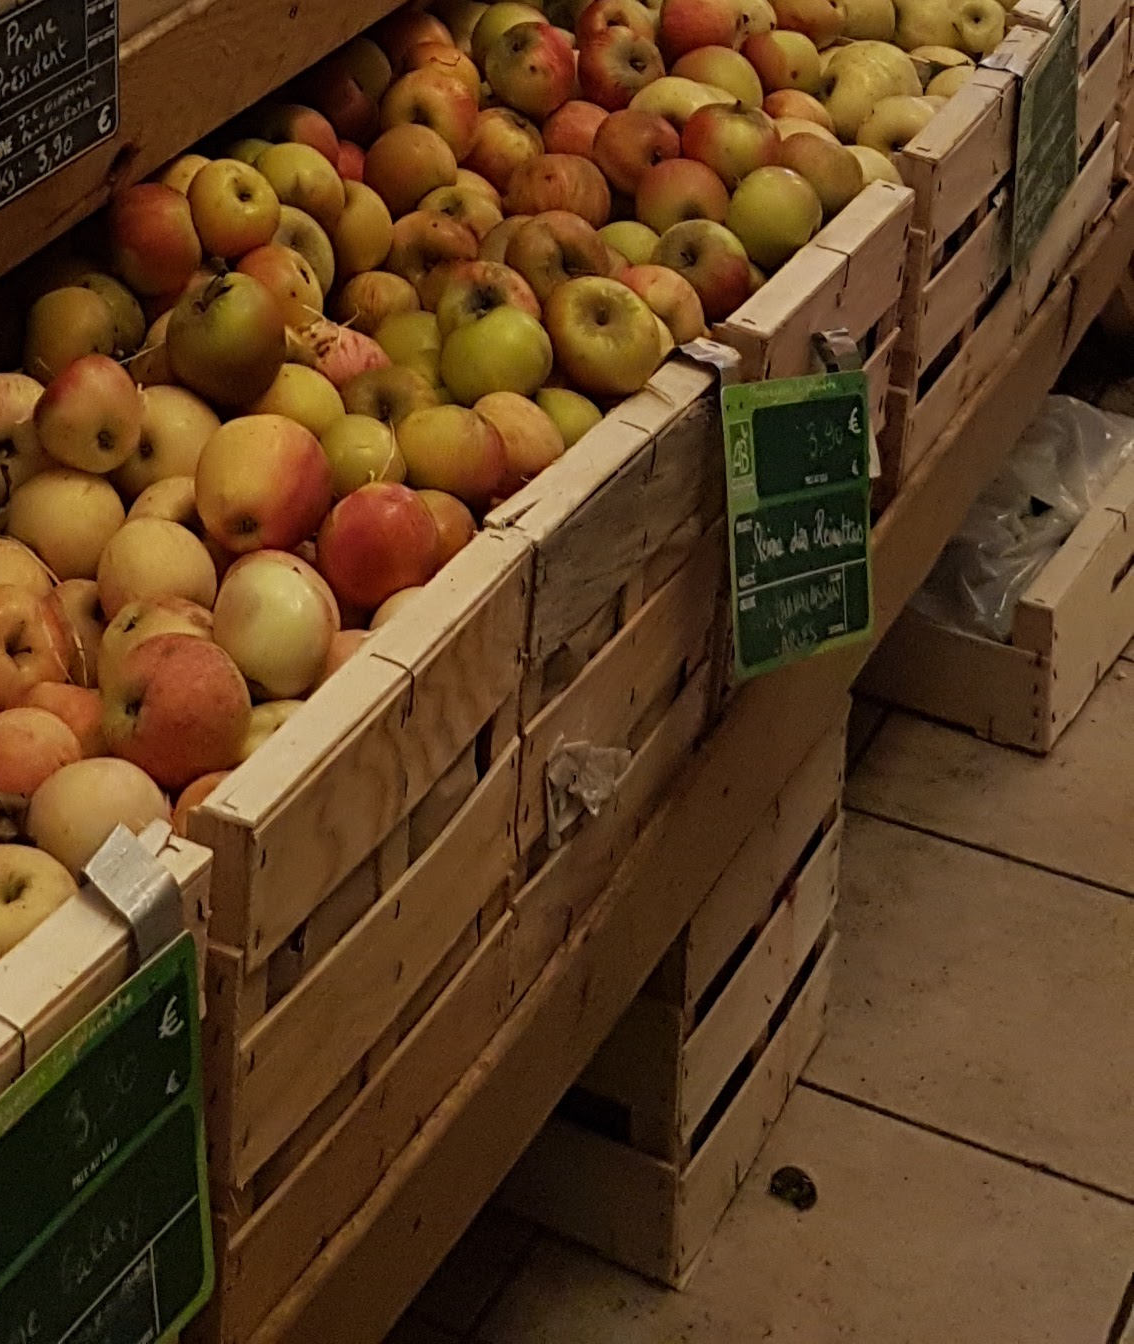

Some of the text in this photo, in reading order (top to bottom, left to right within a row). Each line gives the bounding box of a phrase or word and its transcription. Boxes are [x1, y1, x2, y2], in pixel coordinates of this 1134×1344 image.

[6, 16, 59, 57] Prune
[34, 132, 73, 175] 3,90
[97, 103, 112, 135] €
[848, 406, 863, 435] €
[157, 994, 186, 1040] €
